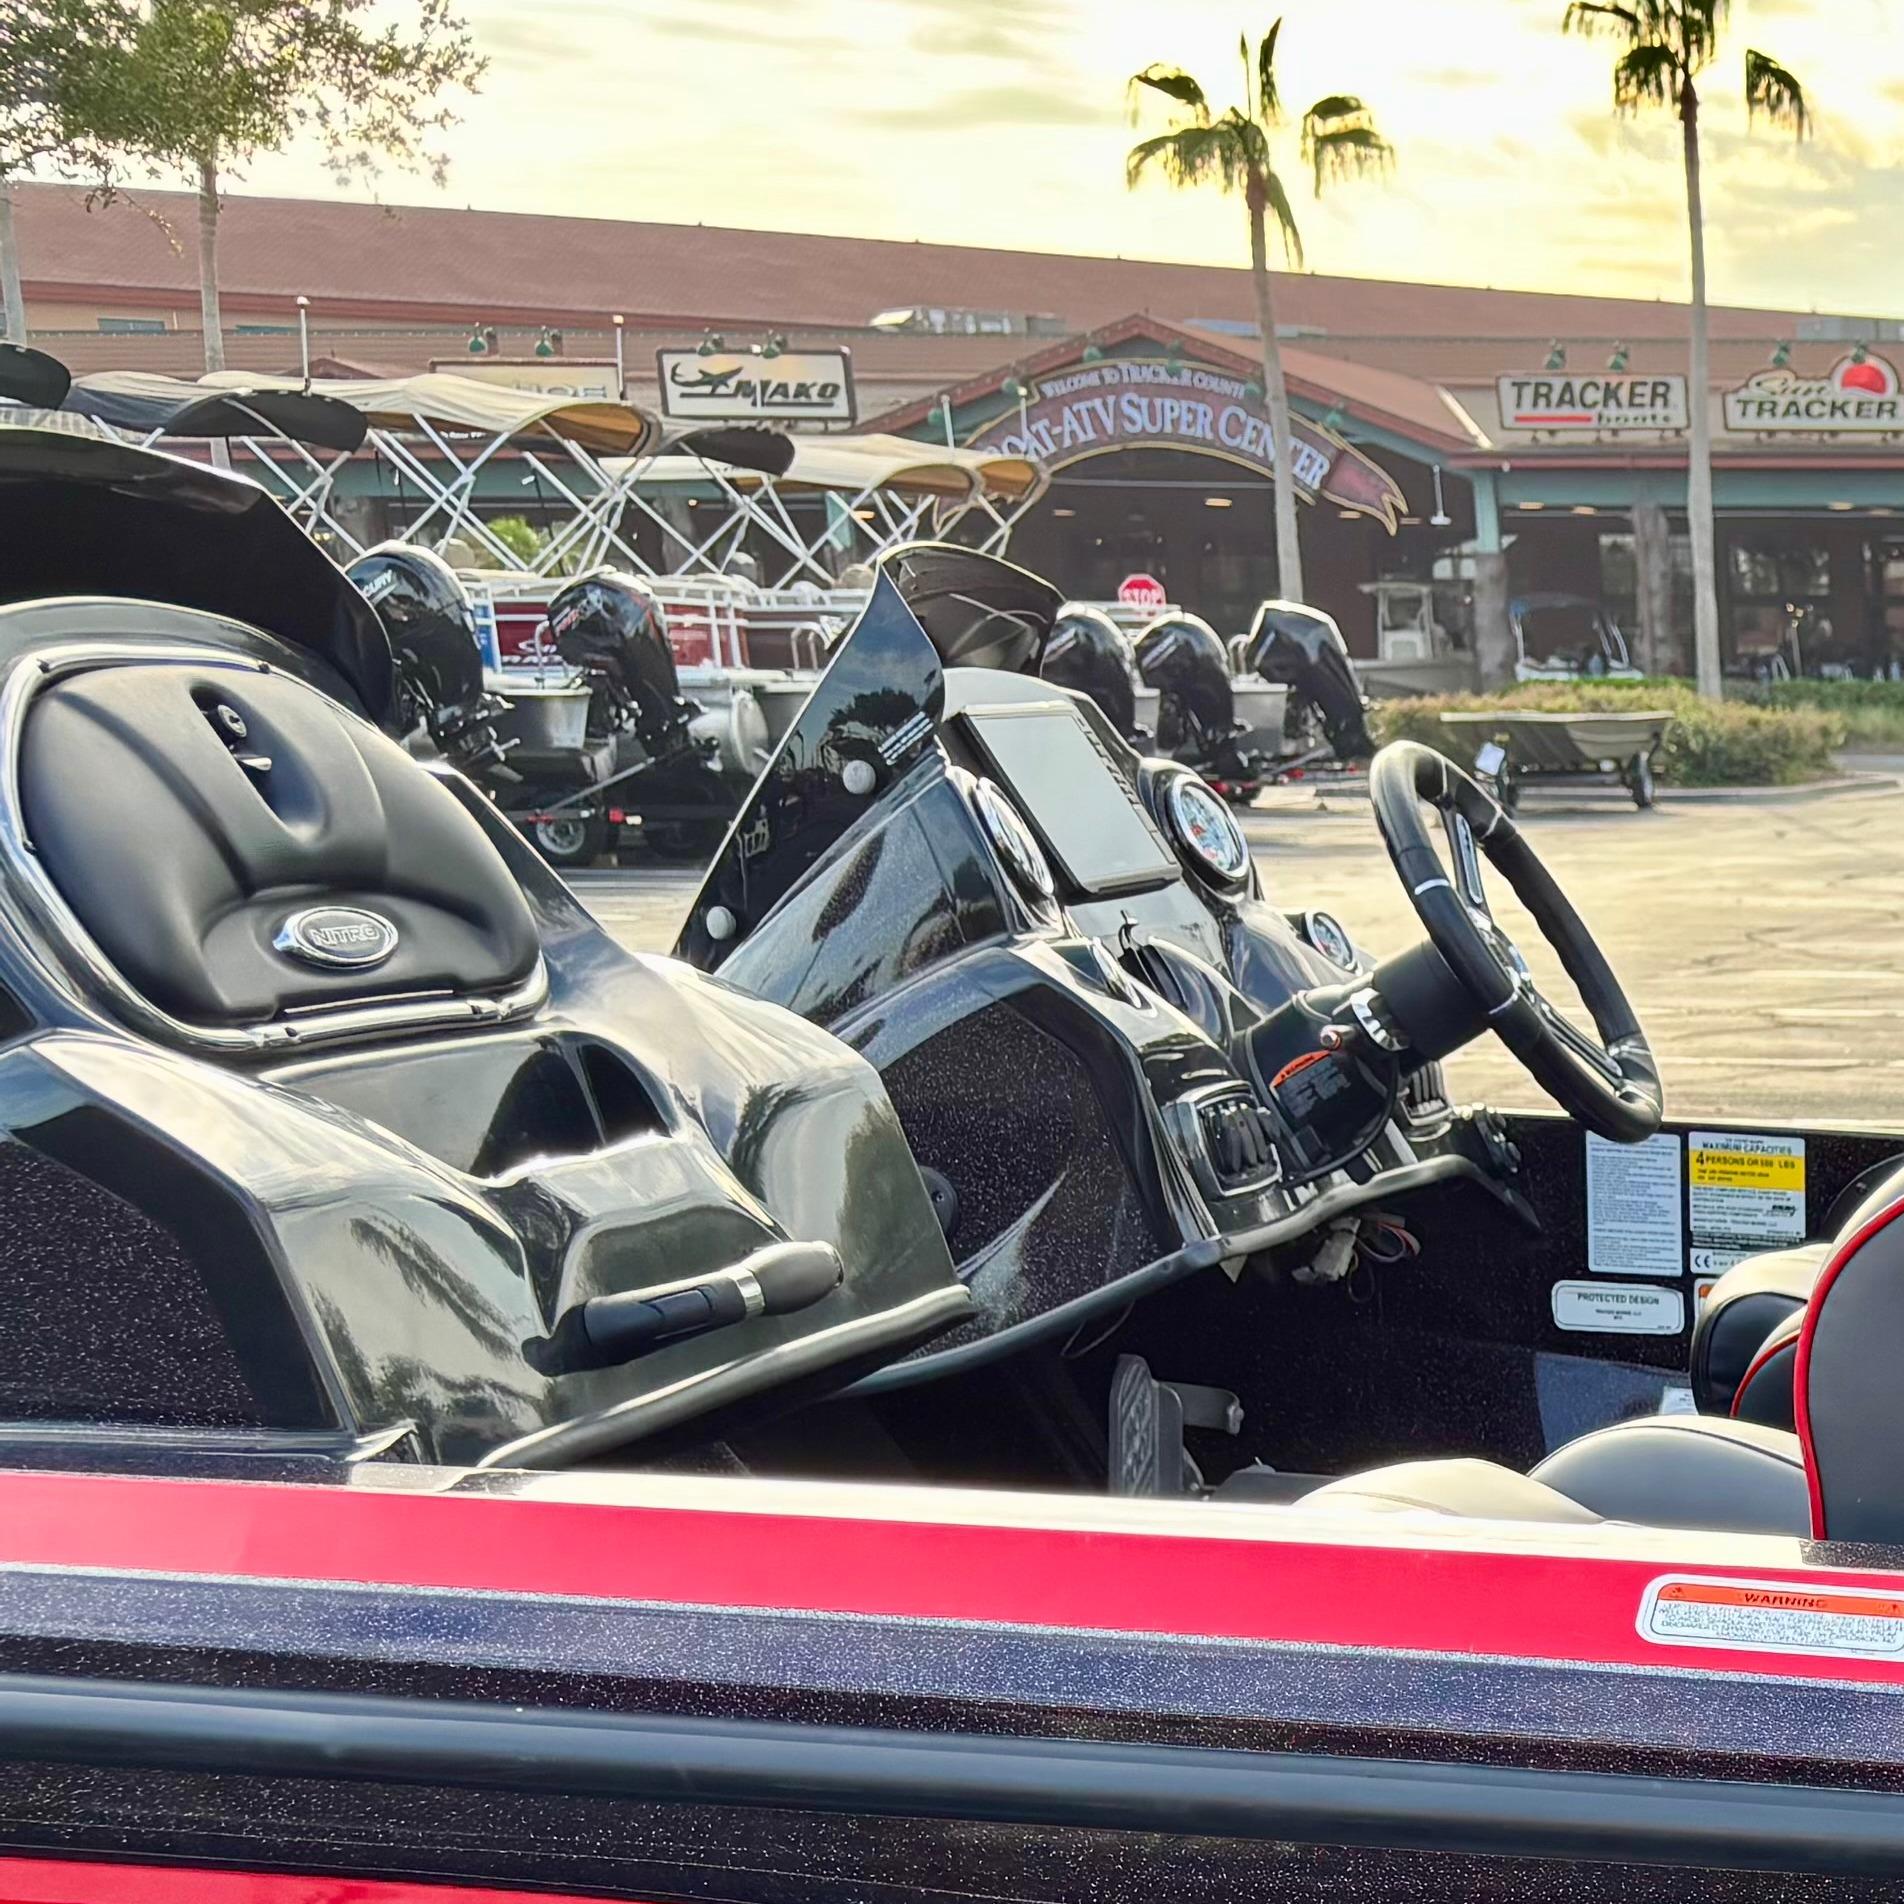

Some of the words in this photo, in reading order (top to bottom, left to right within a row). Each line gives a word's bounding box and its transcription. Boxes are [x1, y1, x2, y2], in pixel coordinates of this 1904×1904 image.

[733, 378, 841, 407] MAKO
[1511, 380, 1672, 409] TRACKER
[1736, 399, 1898, 419] TRACKER
[985, 394, 1117, 461] OAT-ATV
[1122, 391, 1214, 441] SUPER
[308, 923, 380, 946] NITRO
[1577, 1292, 1627, 1304] PROTECTED
[1628, 1295, 1660, 1305] DESIGN
[1744, 1592, 1827, 1609] WARNING
